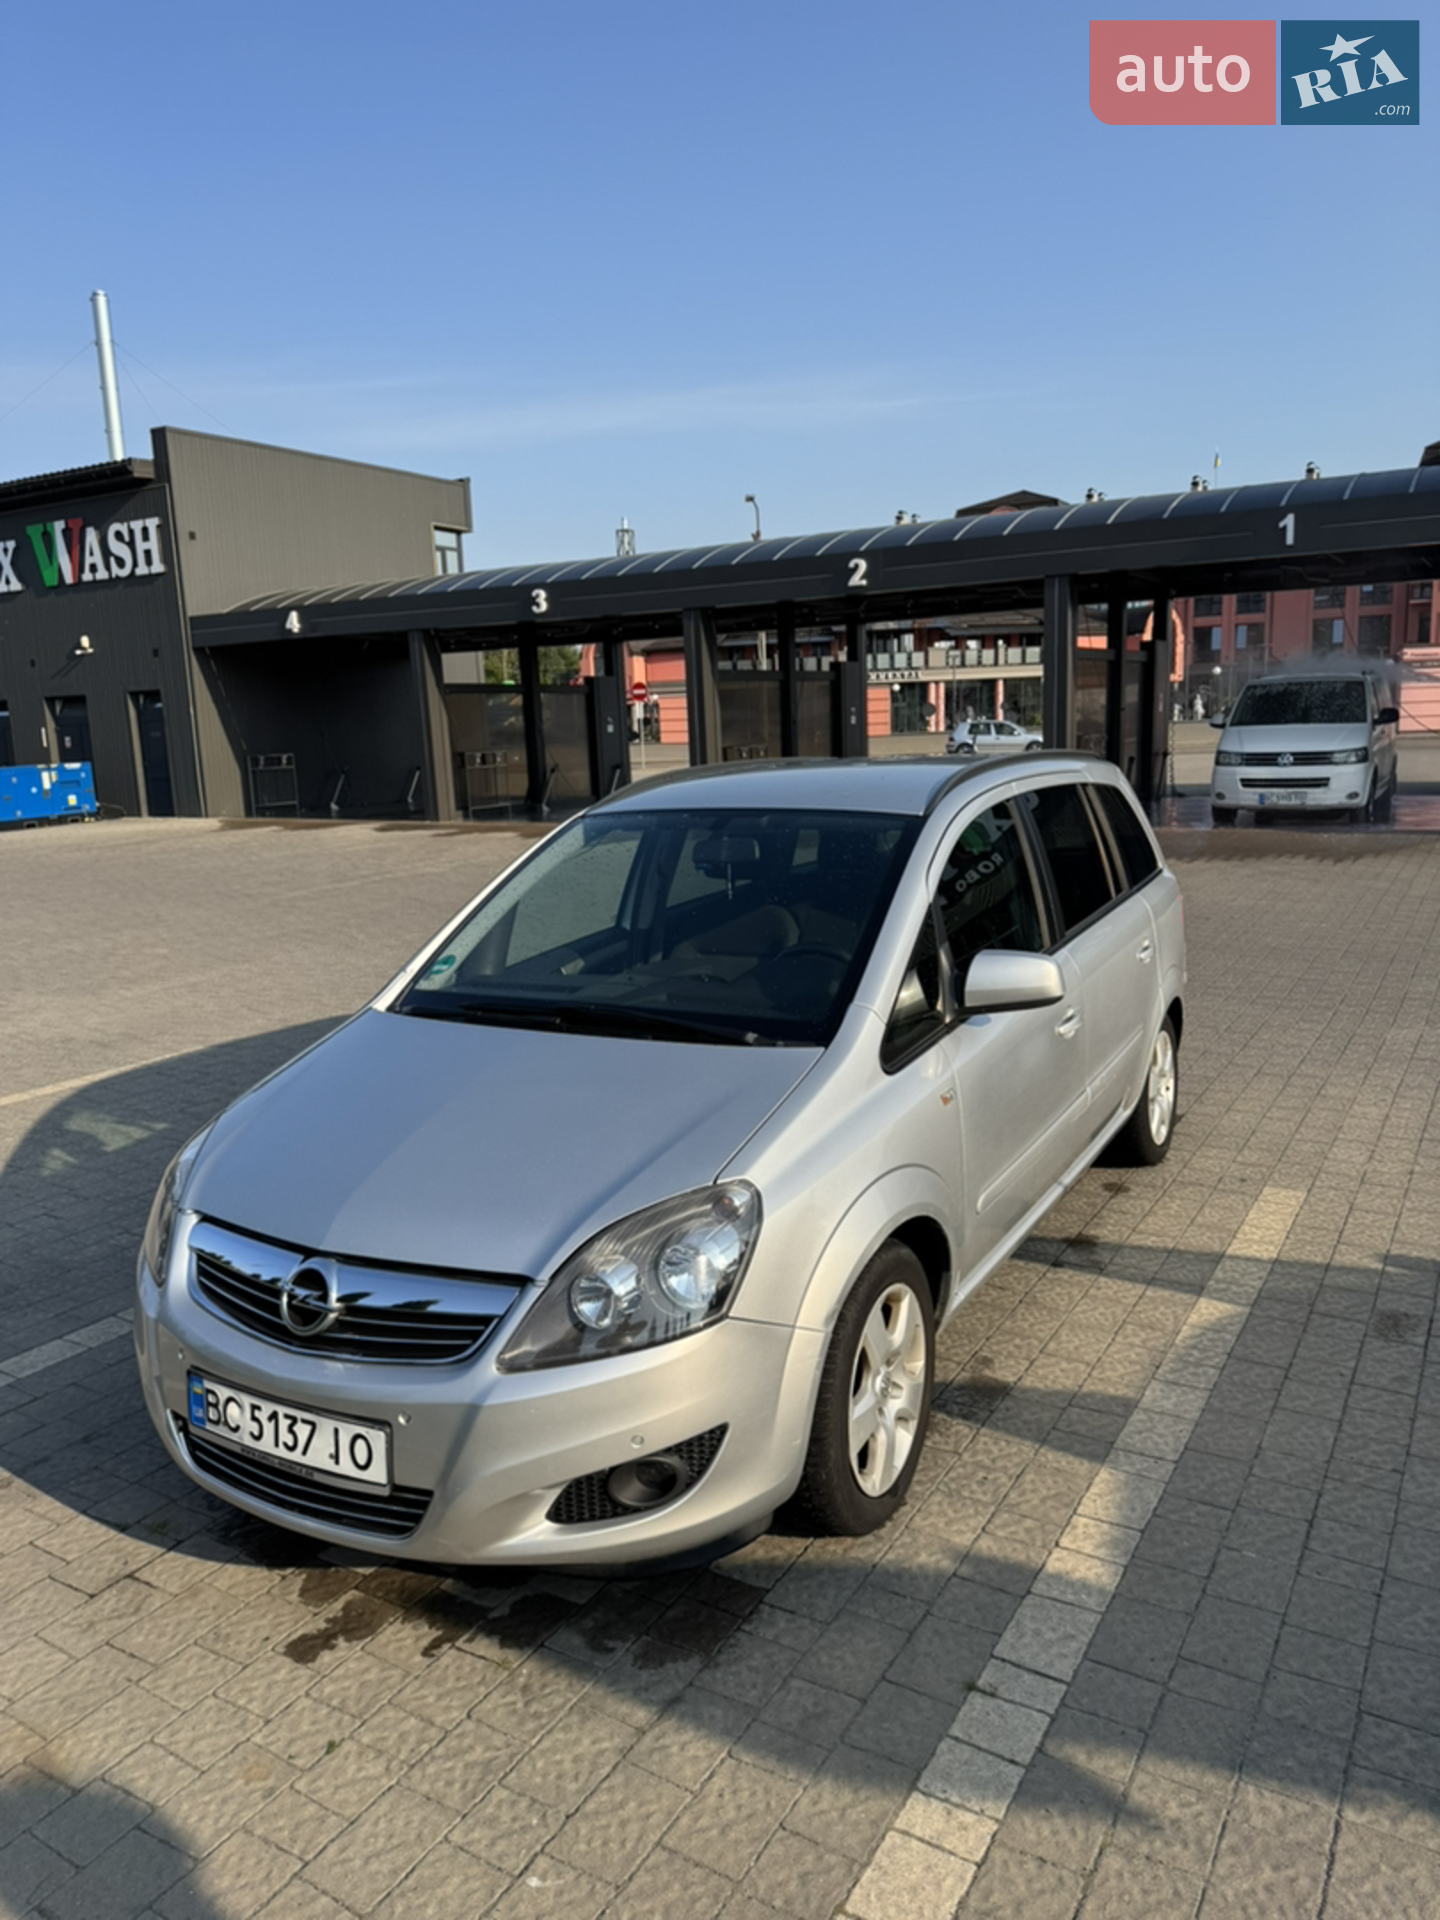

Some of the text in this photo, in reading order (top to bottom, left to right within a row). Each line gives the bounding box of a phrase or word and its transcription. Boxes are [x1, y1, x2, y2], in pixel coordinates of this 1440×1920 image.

[1278, 512, 1296, 546] 1
[25, 516, 166, 588] WASH
[847, 557, 868, 588] 2
[531, 588, 549, 614] 3
[285, 609, 302, 634] 4
[205, 1388, 242, 1433] BC
[248, 1402, 317, 1457] 5137
